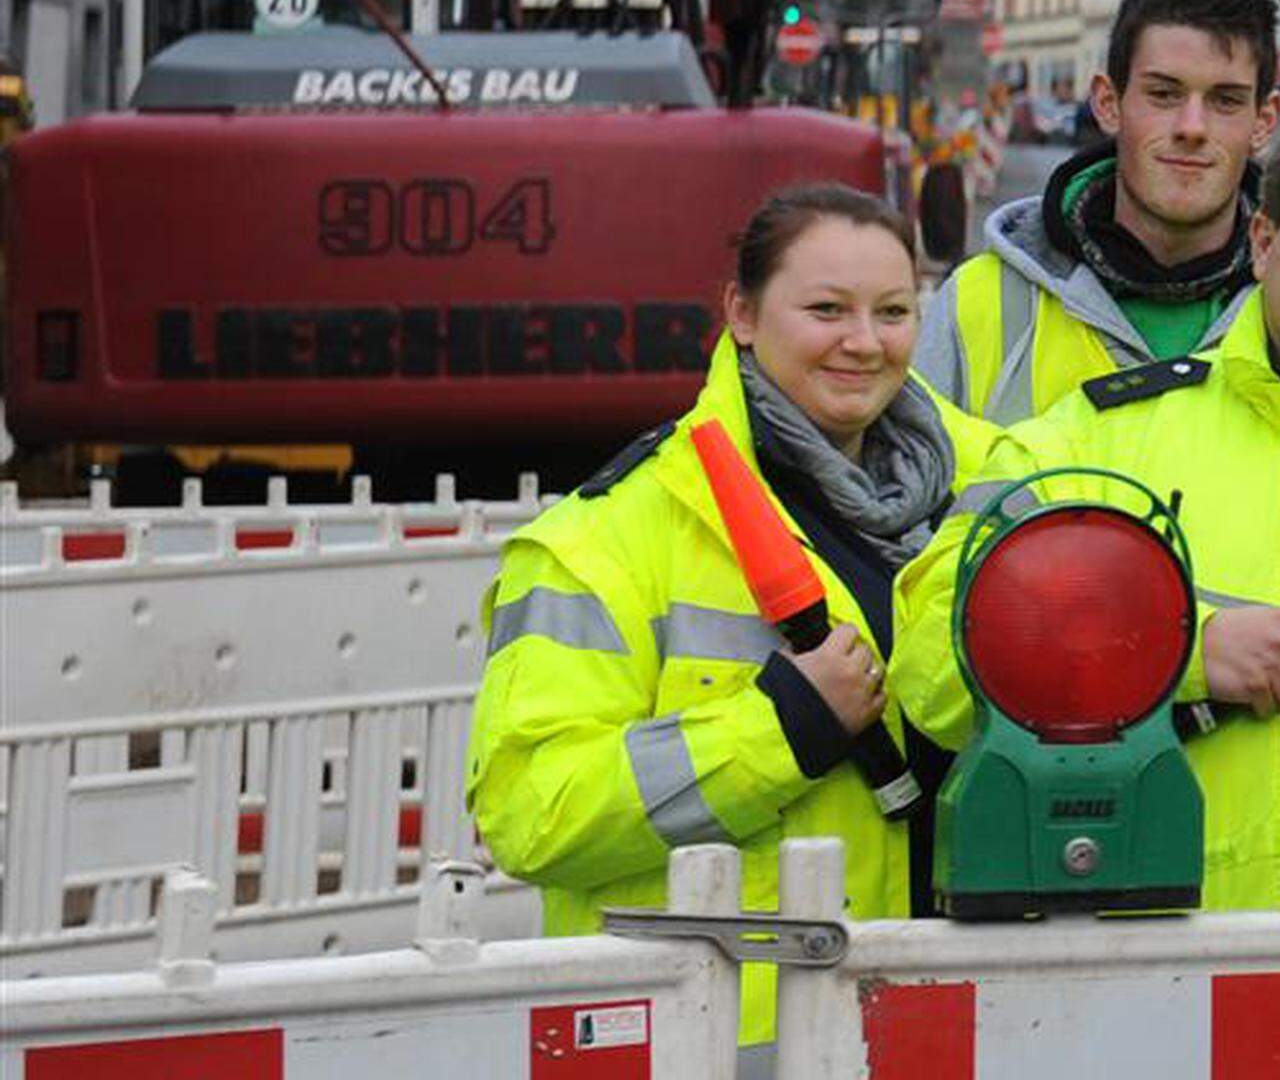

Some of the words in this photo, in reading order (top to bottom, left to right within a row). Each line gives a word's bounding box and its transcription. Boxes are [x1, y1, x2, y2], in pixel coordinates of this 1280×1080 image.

[293, 69, 473, 104] BACKES
[480, 69, 579, 102] BAU
[317, 177, 557, 258] 904
[156, 301, 714, 380] LIEBHERR
